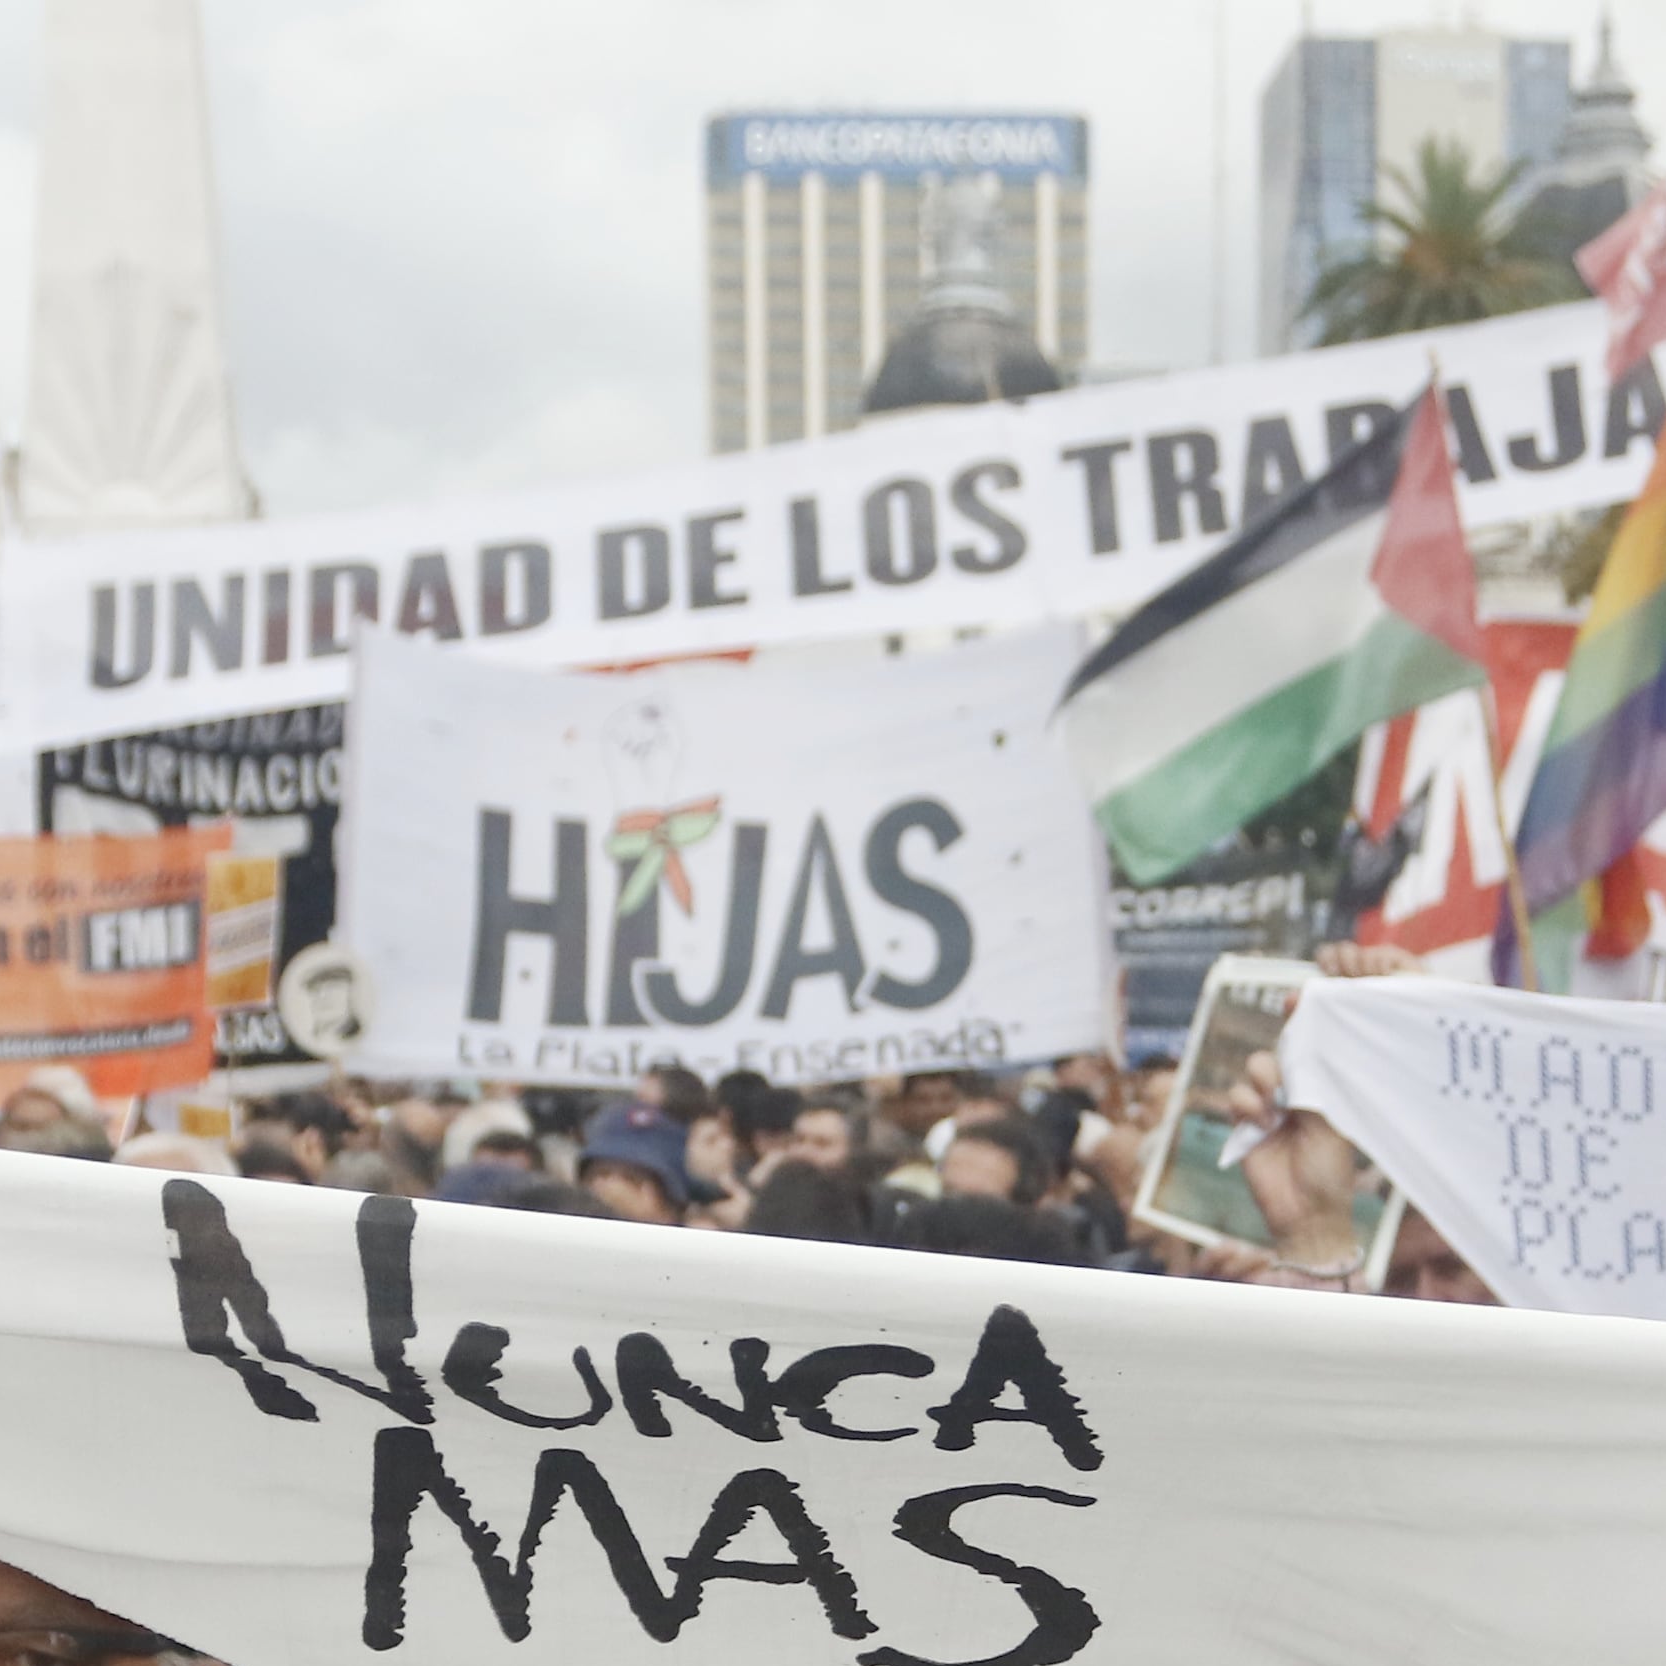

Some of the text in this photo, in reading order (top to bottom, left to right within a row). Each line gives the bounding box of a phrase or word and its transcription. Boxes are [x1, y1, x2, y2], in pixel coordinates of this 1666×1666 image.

[88, 536, 553, 690] UNIDAD
[595, 509, 749, 622] DE
[790, 459, 1028, 599] LOS
[89, 904, 192, 971] FMI
[465, 791, 975, 1030] HIJAS
[456, 1033, 514, 1068] La
[1497, 1112, 1622, 1201] DE
[160, 1177, 1105, 1472] NUNCA
